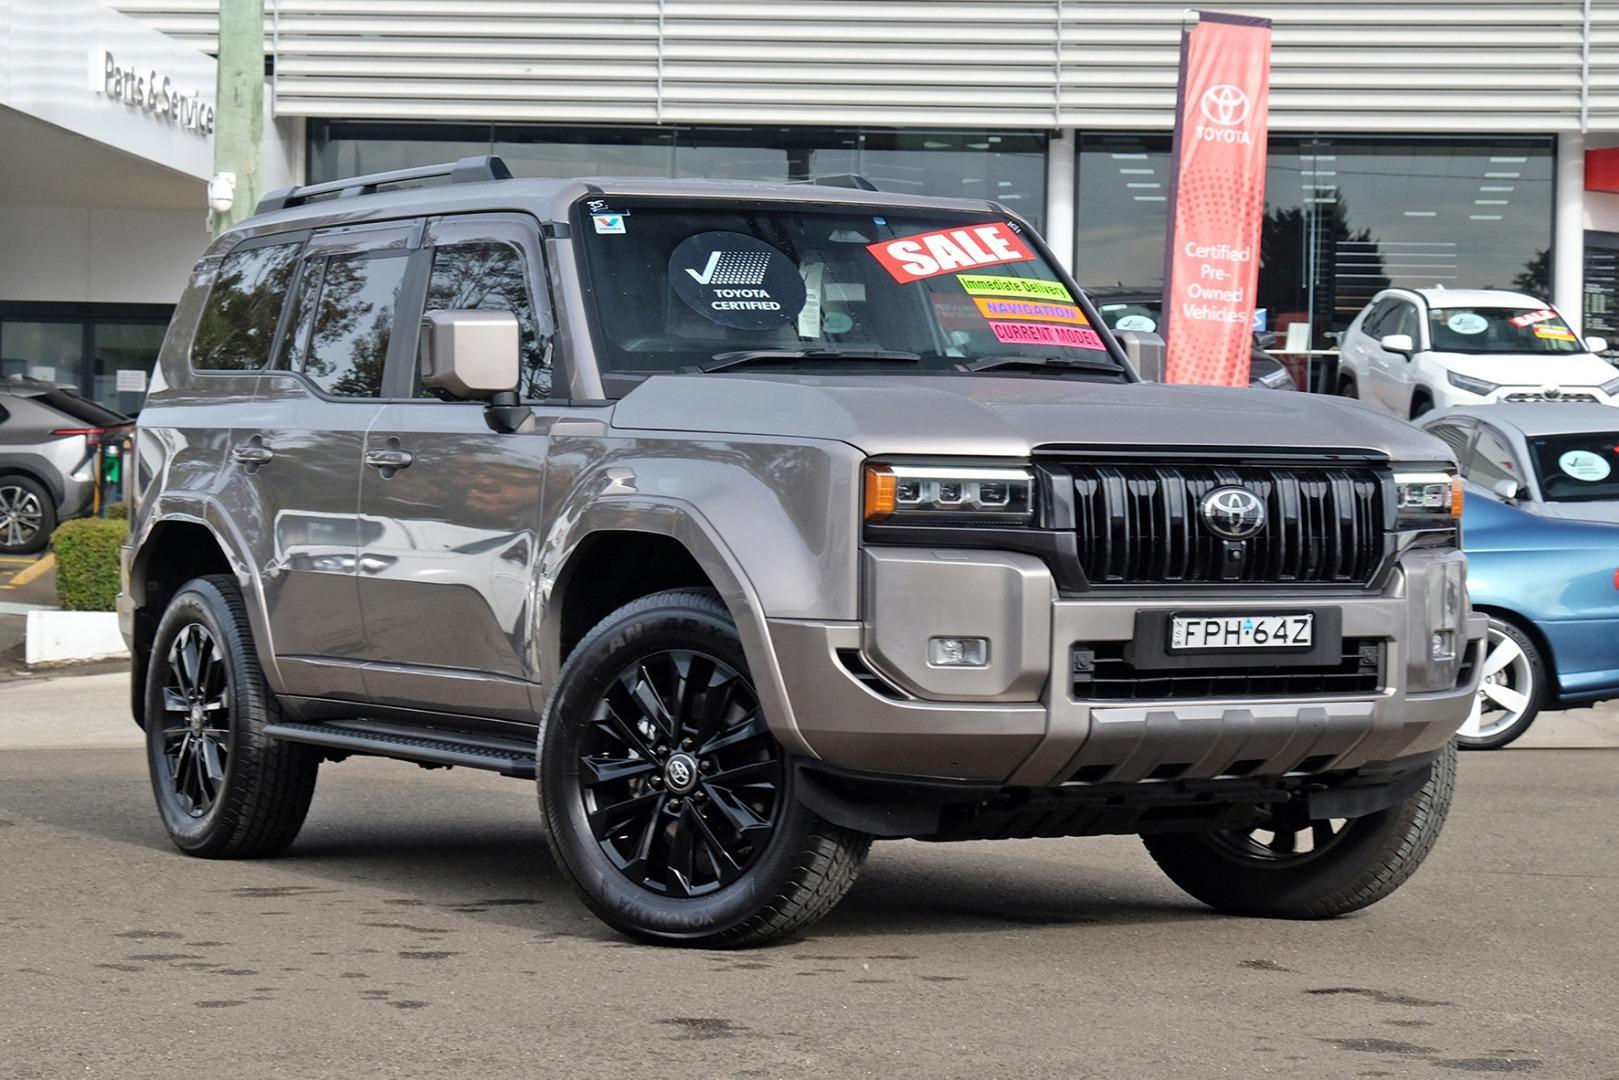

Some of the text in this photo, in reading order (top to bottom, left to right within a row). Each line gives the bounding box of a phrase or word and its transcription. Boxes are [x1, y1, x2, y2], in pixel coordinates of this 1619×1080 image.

[103, 50, 214, 135] Parts & Service
[1195, 126, 1251, 145] TOYOTA
[887, 226, 1023, 276] SALE
[1184, 241, 1250, 262] Certified
[1200, 264, 1231, 280] Pre-
[713, 289, 771, 298] TOYOTA
[961, 277, 1067, 298] Immediate Delivery
[1187, 284, 1244, 302] Owned
[711, 301, 781, 311] CERTIFIED
[986, 302, 1077, 319] NAVIGATION
[1183, 304, 1248, 323] Vehicles
[994, 324, 1100, 346] CURRENT MODEL
